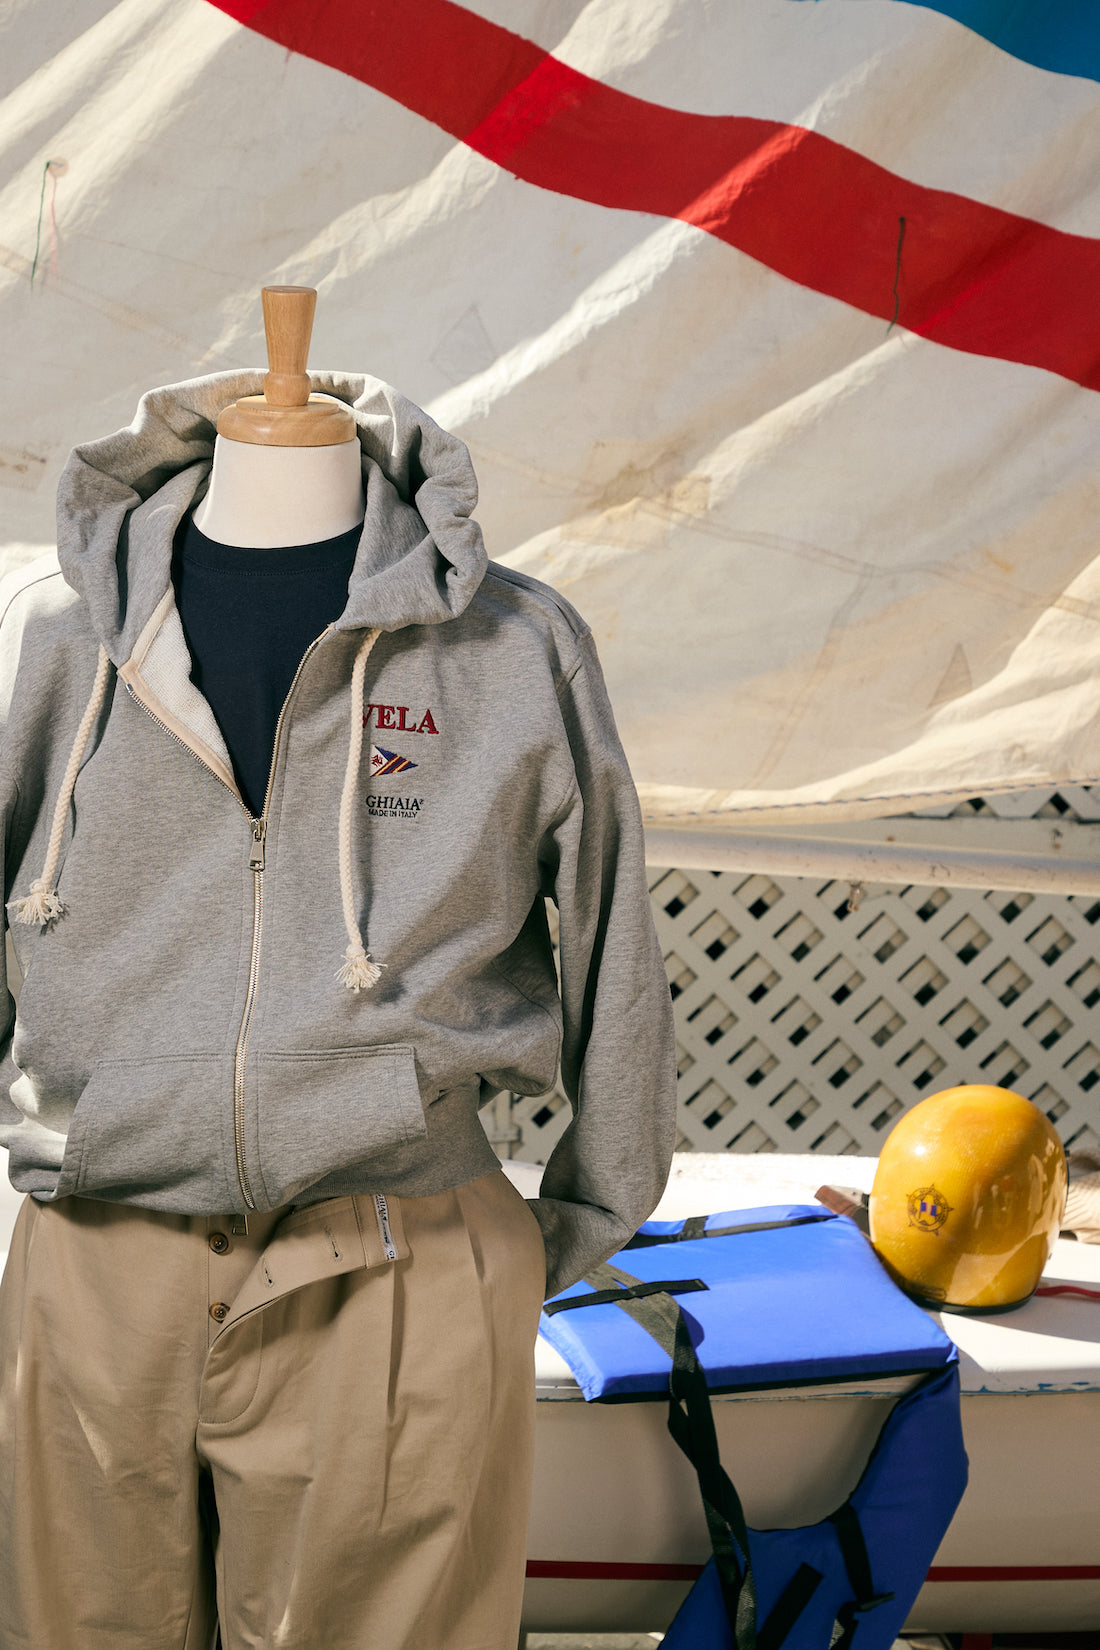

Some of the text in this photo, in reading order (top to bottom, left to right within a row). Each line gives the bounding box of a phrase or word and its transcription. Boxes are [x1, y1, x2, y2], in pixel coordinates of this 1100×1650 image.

[368, 808, 418, 819] MADE IN ITALY
